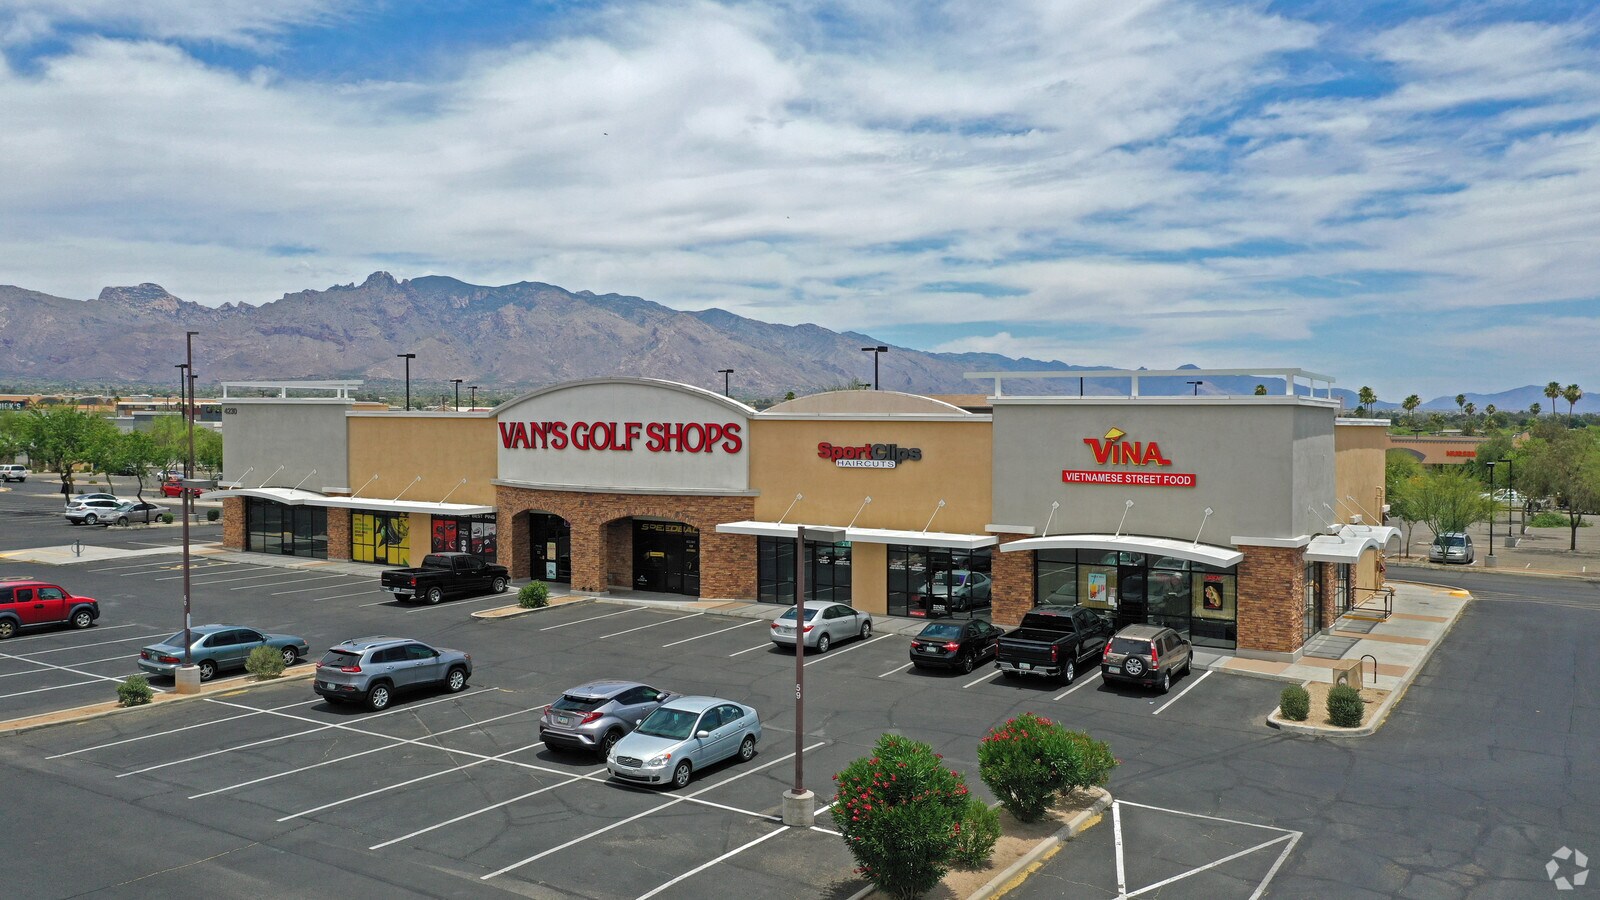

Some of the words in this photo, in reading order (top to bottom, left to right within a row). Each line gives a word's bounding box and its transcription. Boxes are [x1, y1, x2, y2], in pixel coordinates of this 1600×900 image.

[499, 421, 568, 450] VAN'S
[570, 421, 642, 451] GOLF
[645, 422, 742, 454] SHOPS
[836, 460, 895, 468] HAIRCUTS
[1065, 472, 1123, 483] VIETNAMESE
[1125, 474, 1162, 484] STREET
[1164, 475, 1191, 485] FOOD
[795, 683, 801, 700] 59
